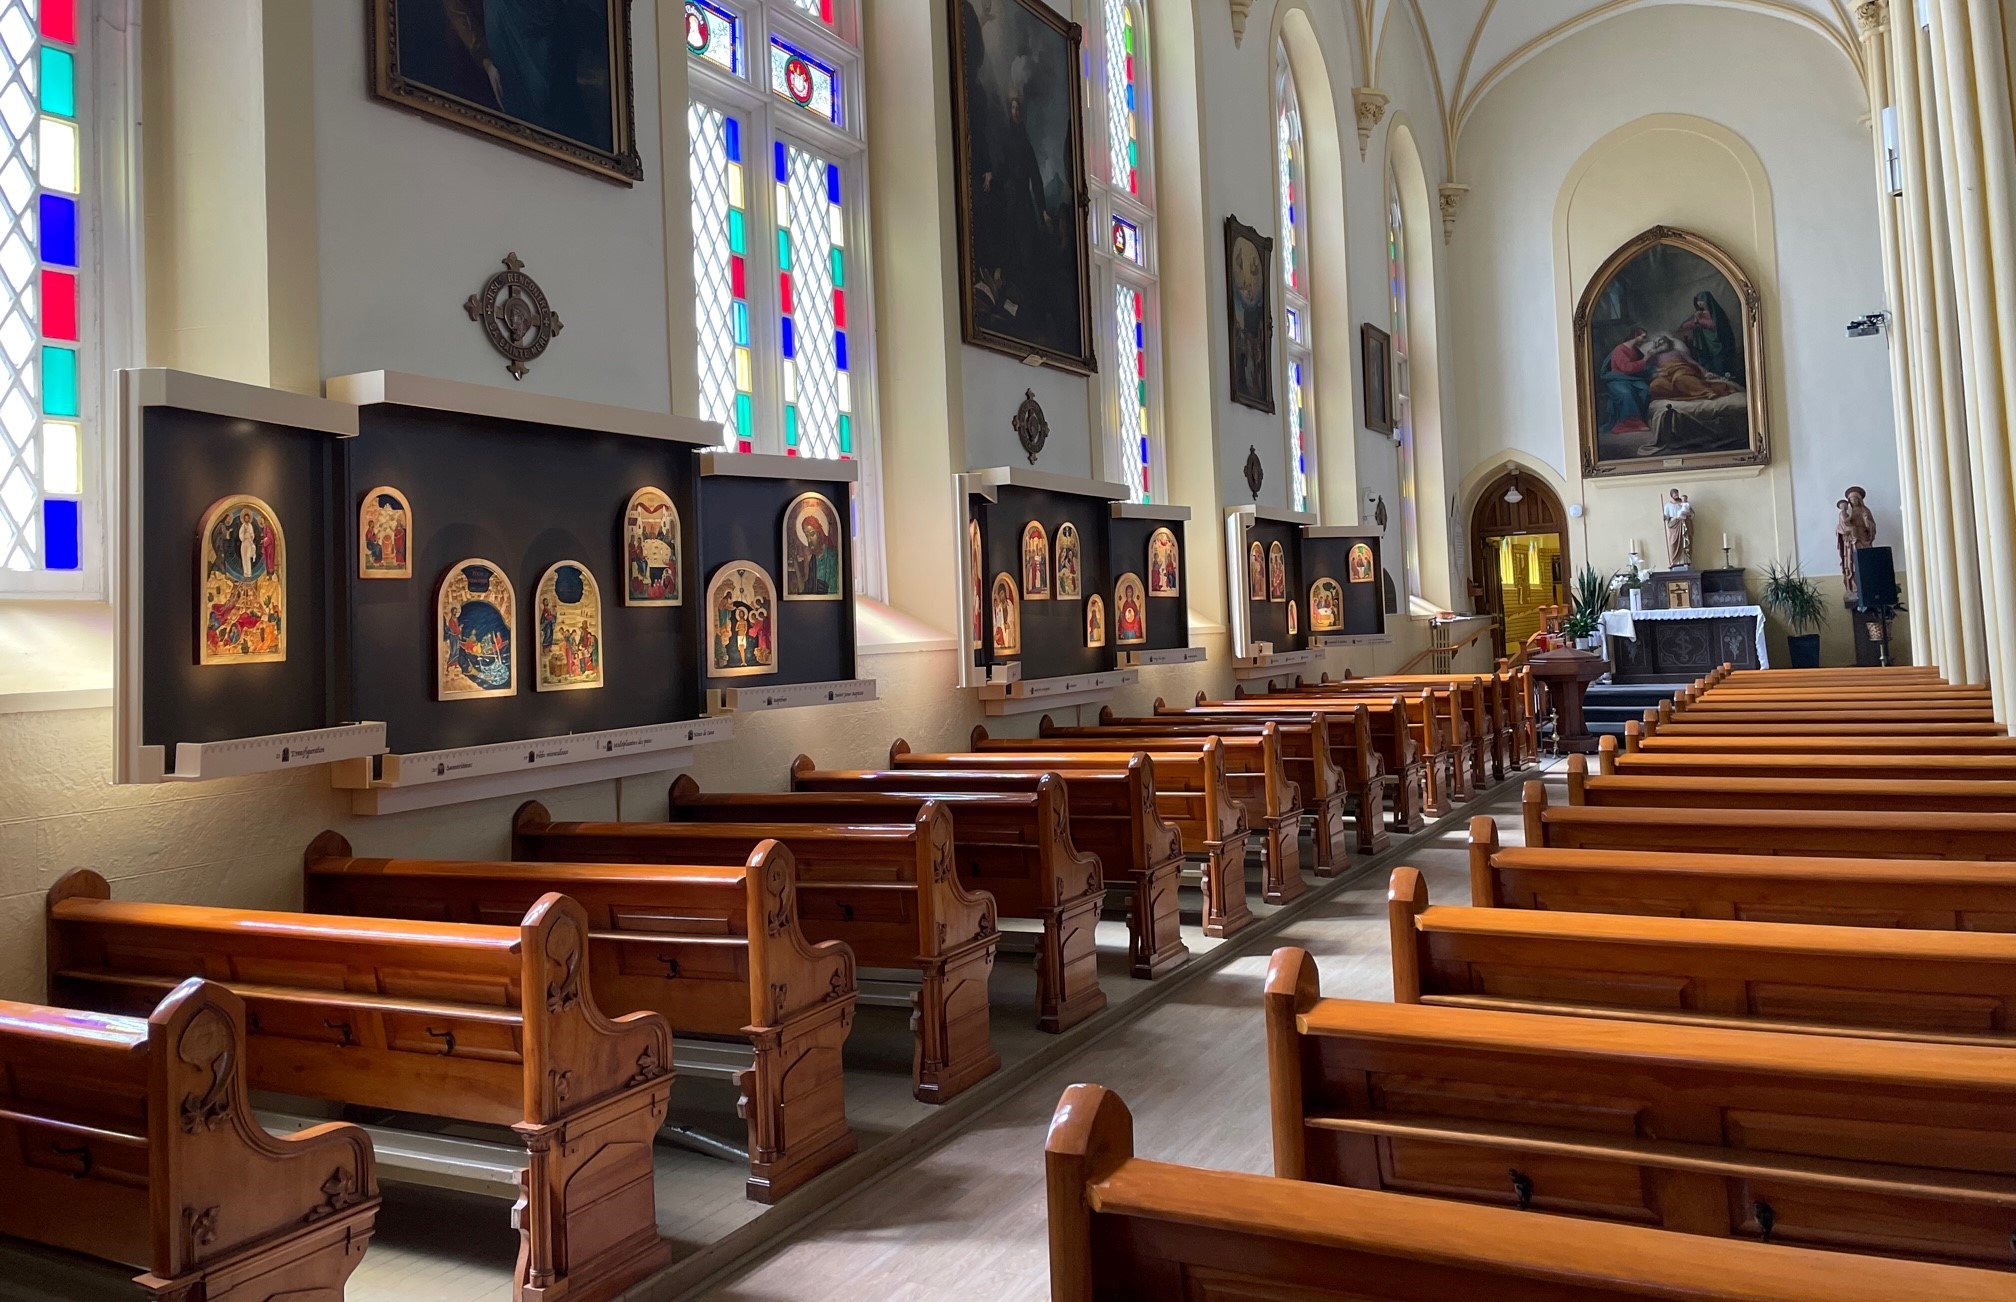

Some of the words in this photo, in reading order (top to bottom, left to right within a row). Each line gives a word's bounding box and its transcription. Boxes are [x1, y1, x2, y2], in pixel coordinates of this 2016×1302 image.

[508, 273, 549, 314] RENCONTRE
[490, 323, 499, 337] SA
[500, 339, 529, 358] SAINTE
